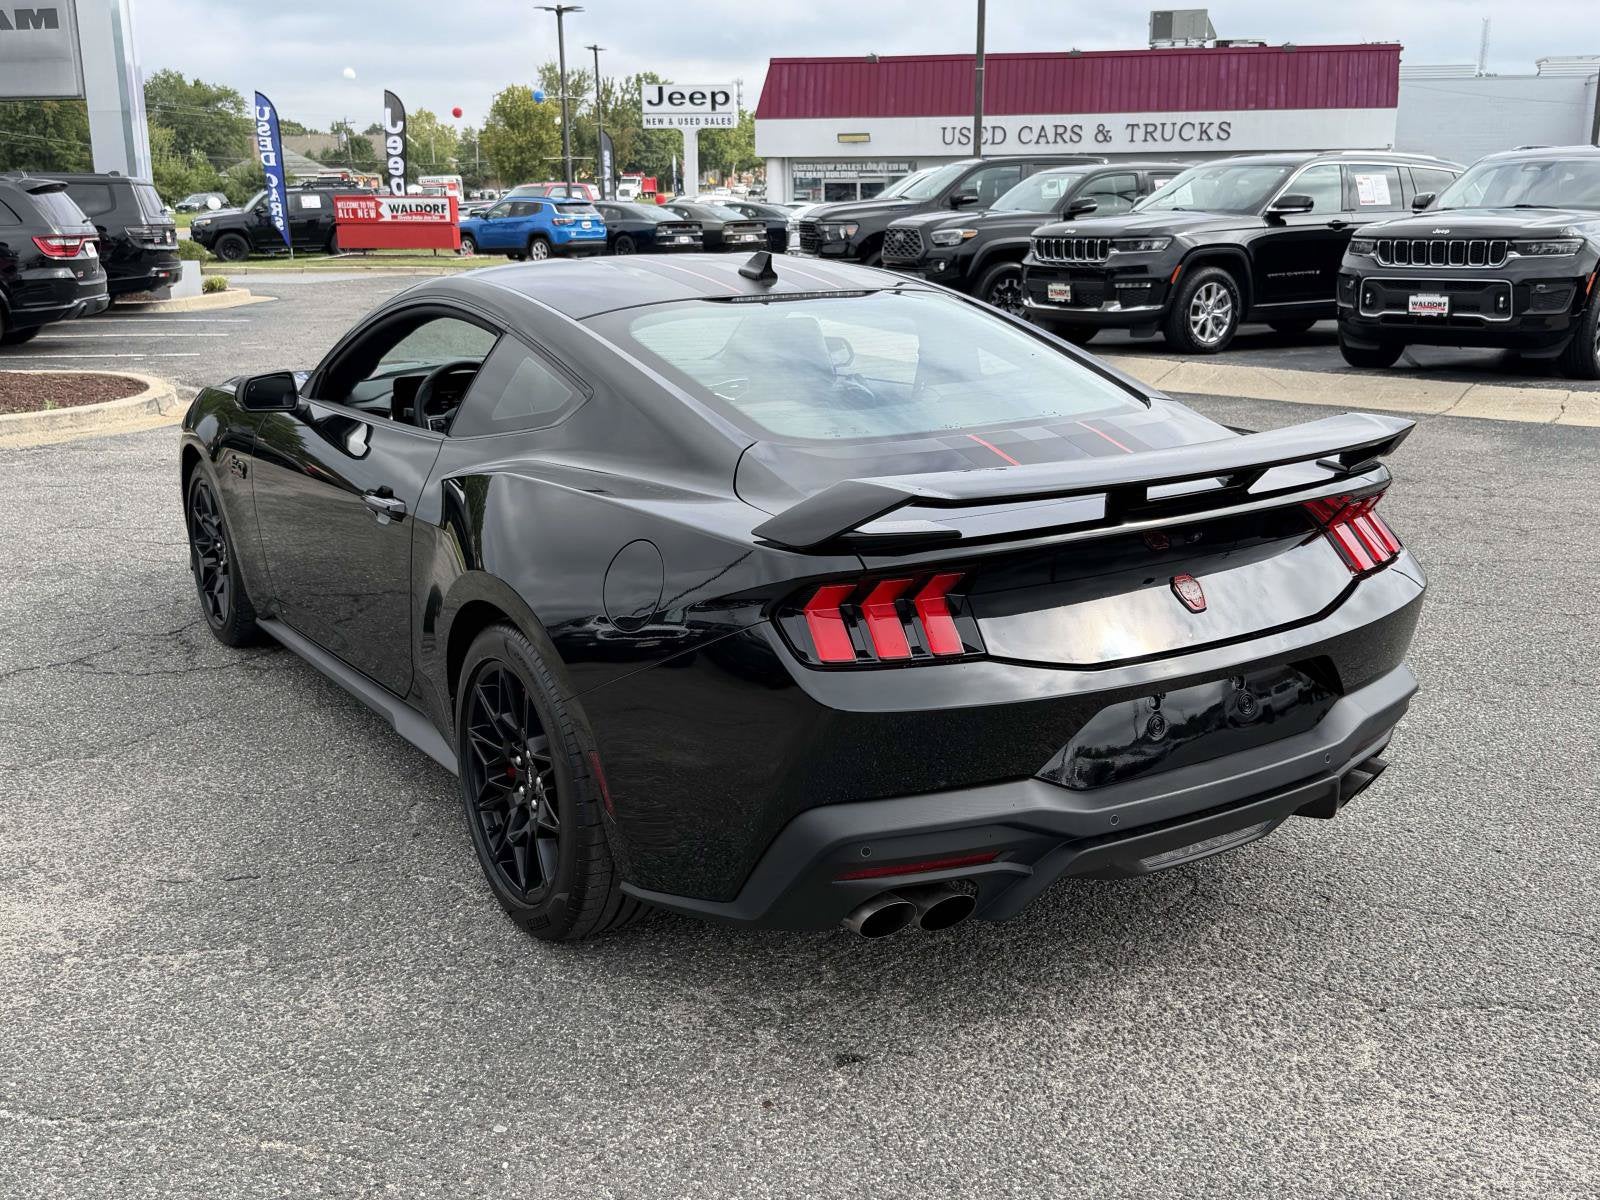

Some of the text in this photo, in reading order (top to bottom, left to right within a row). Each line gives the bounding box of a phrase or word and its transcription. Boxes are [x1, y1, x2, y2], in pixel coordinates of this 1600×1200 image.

[647, 86, 730, 112] Jeep
[646, 118, 664, 126] NEW
[678, 117, 701, 126] USED
[704, 117, 732, 126] SALES
[941, 121, 1232, 146] USED CARS & TRUCKS
[836, 163, 861, 171] SALES
[337, 201, 376, 209] WELCOME TO THE
[388, 203, 447, 214] WALDORF
[338, 208, 377, 219] ALL NEW
